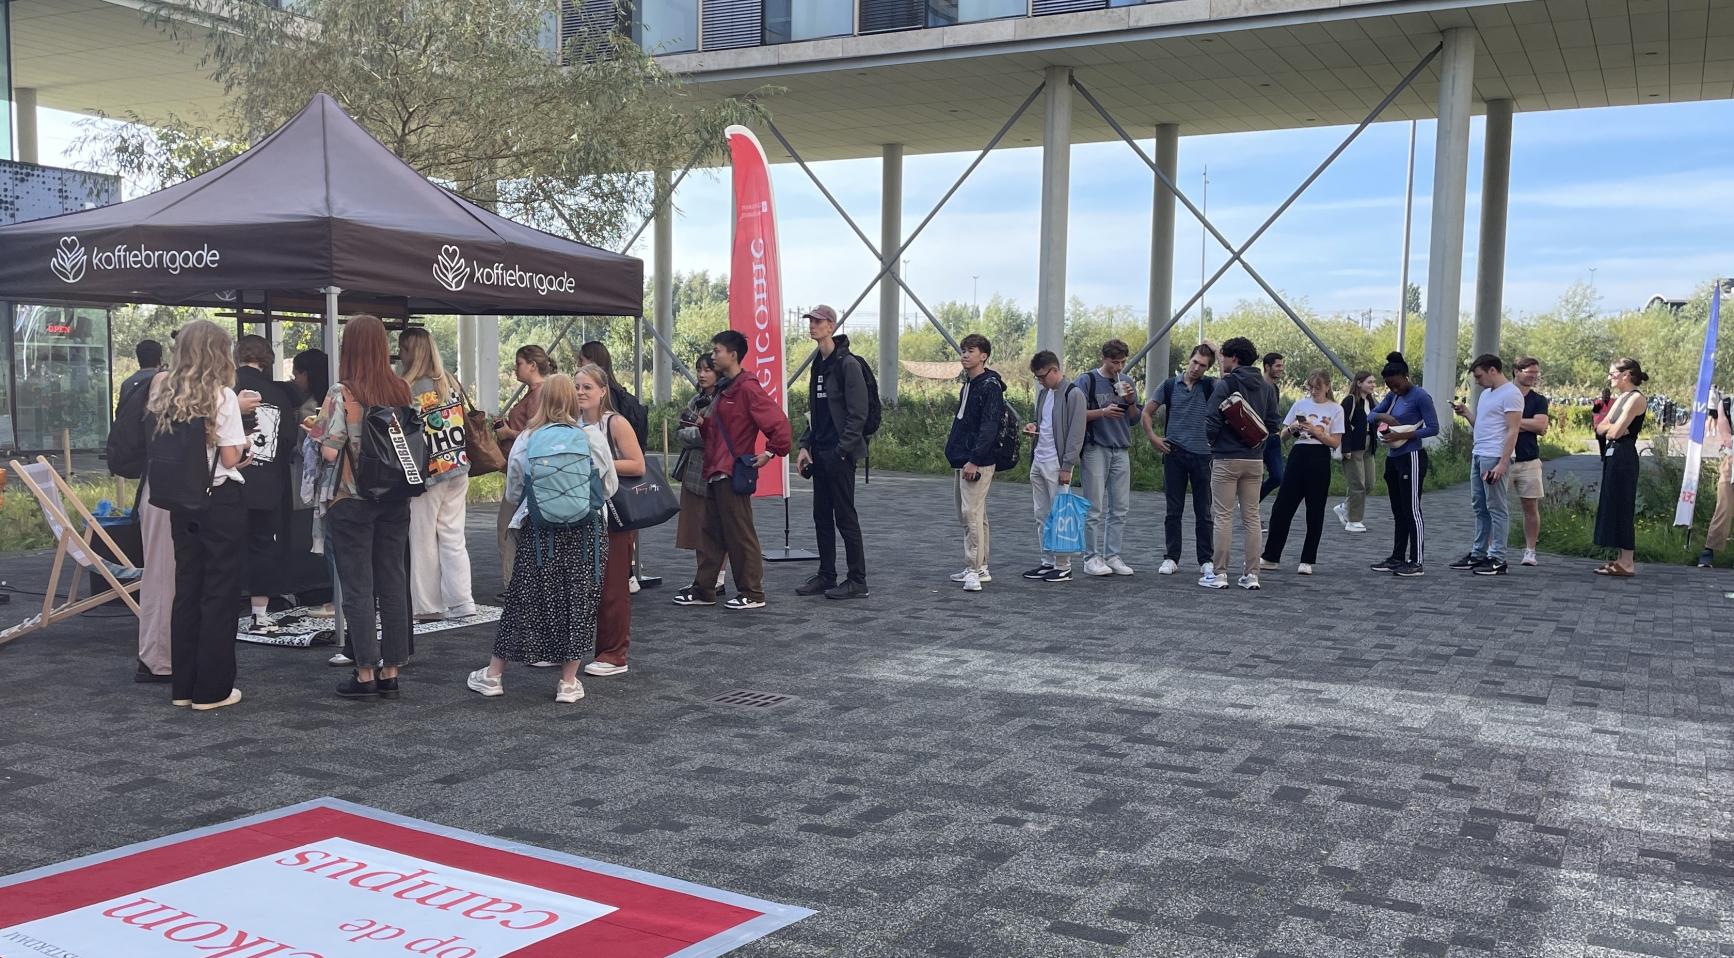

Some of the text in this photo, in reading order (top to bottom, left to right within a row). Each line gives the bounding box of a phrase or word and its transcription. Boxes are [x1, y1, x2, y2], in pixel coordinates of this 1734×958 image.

[92, 243, 220, 275] koffiebrigade
[473, 260, 576, 296] koffiebrigade
[47, 325, 71, 334] OPEN
[274, 850, 560, 930] campus
[338, 918, 477, 958] op de
